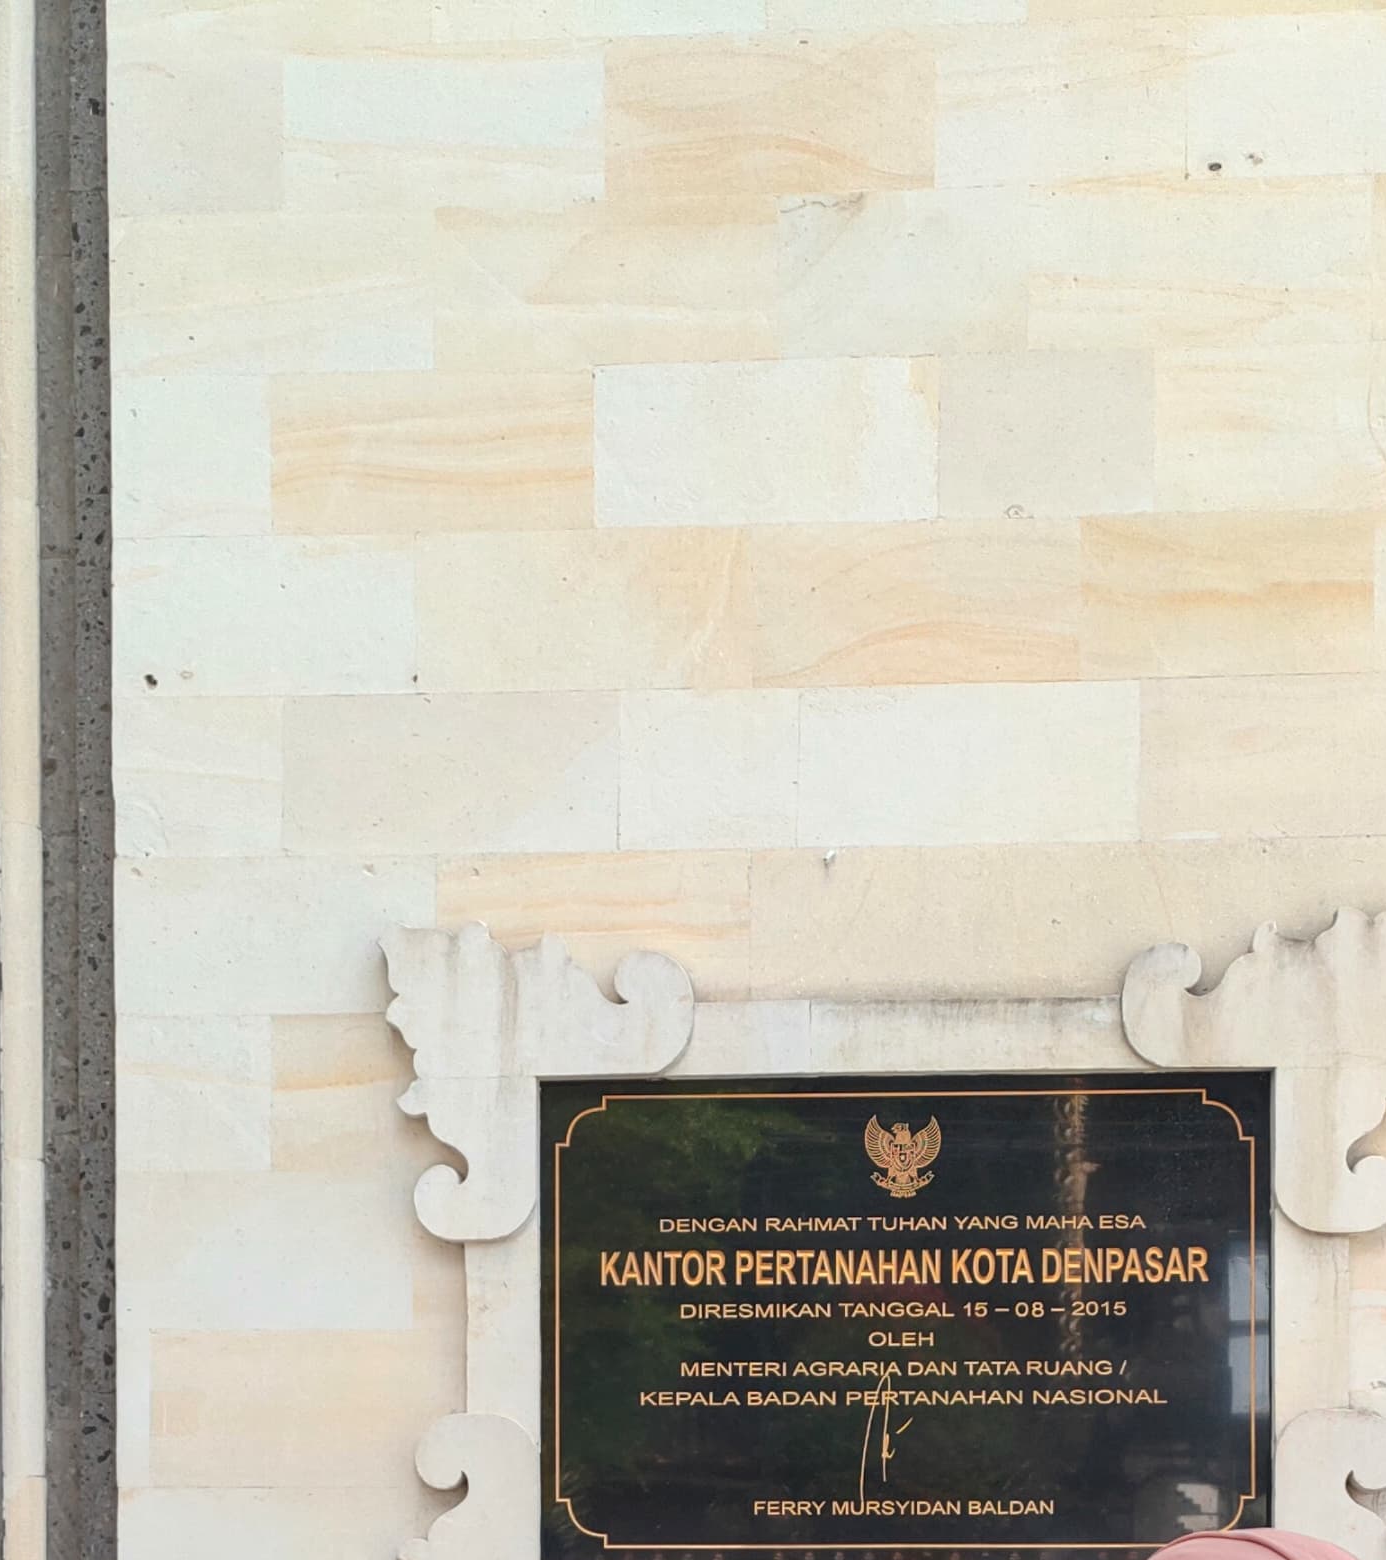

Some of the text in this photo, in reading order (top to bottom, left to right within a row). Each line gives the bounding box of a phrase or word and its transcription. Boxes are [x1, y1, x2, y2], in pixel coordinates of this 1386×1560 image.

[659, 1214, 1146, 1233] DENGAN RAHMAT TUHAN YANG MAHA ESA
[600, 1246, 1209, 1287] KANTOR PERTANAHAN KOTA DENPASAR
[680, 1303, 832, 1320] DIRESMIKAN
[838, 1301, 955, 1318] TANGGAL
[963, 1301, 988, 1318] 15
[1014, 1301, 1045, 1318] 08
[1071, 1301, 1127, 1317] 2015
[868, 1331, 934, 1347] OLEH
[680, 1361, 787, 1377] MENTERI
[792, 1361, 902, 1377] AGRARIA
[907, 1360, 957, 1377] DAN
[963, 1360, 1021, 1376] TATA
[1026, 1360, 1112, 1376] RUANG
[640, 1388, 1167, 1407] KEPALA BADAN PERTANAHAN NASIONAL
[753, 1500, 1054, 1516] FERRY MURSYIDAN BALDAN
